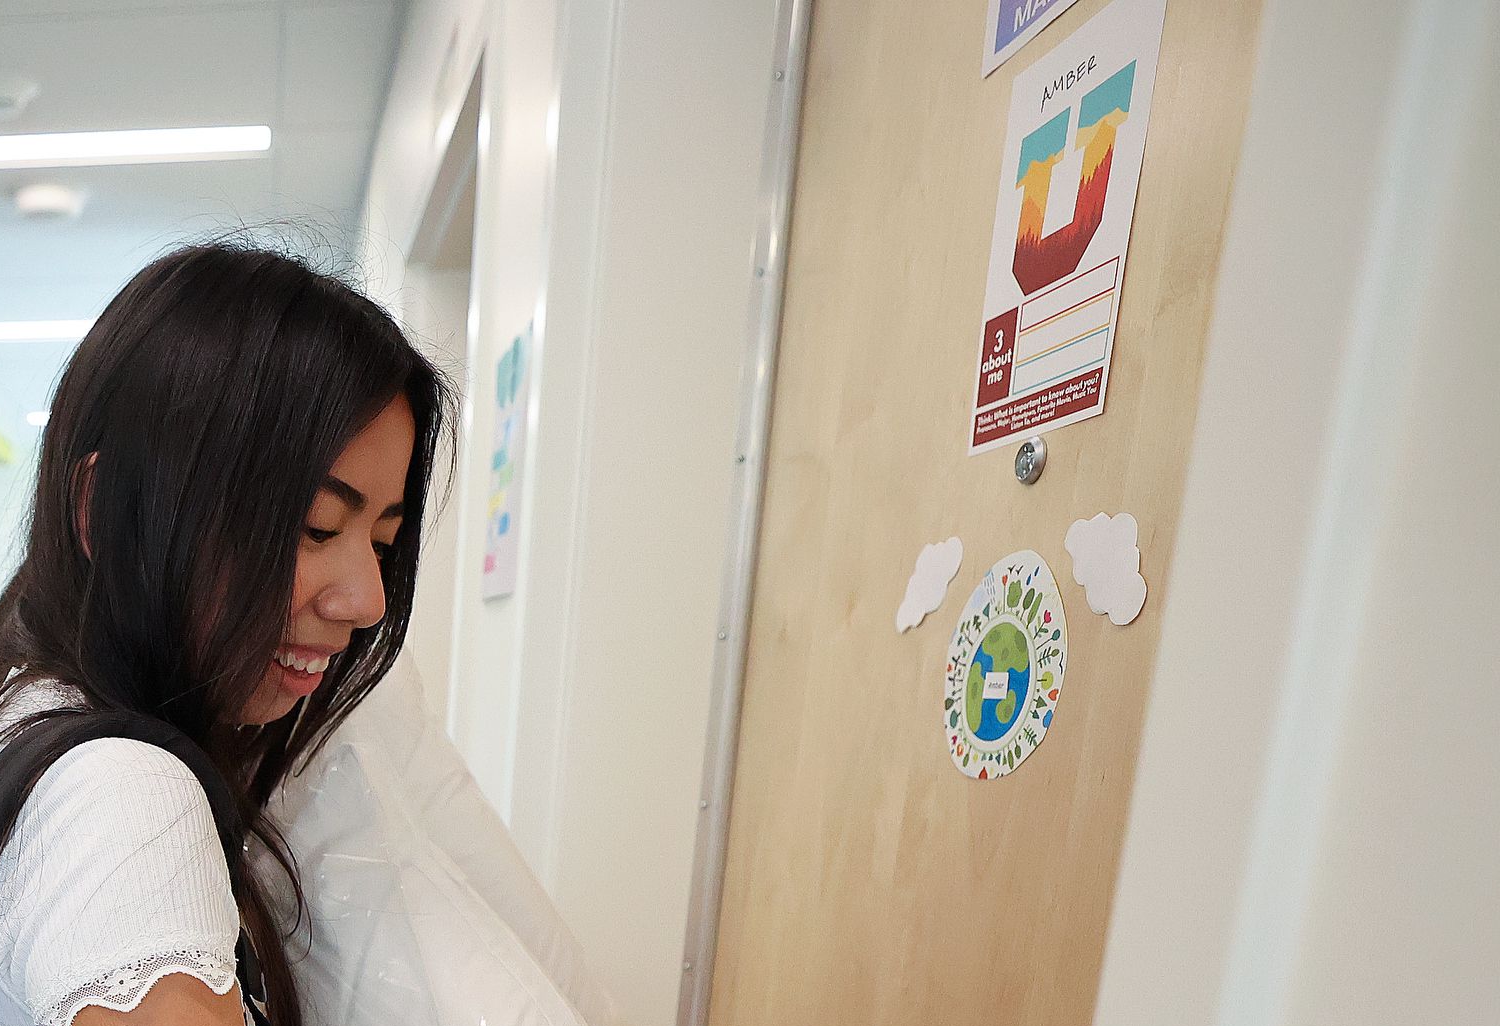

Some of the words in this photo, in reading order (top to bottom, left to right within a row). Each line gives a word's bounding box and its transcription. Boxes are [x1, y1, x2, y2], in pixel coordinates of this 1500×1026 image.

[1041, 55, 1097, 113] AMBER
[994, 329, 1004, 353] 3
[982, 347, 1012, 374] about
[987, 369, 1003, 385] me
[994, 408, 1008, 420] What
[1014, 395, 1041, 414] important
[1042, 395, 1047, 404] to
[1048, 389, 1065, 400] know
[1065, 380, 1083, 395] about
[1082, 372, 1100, 391] you?
[1087, 386, 1098, 395] You
